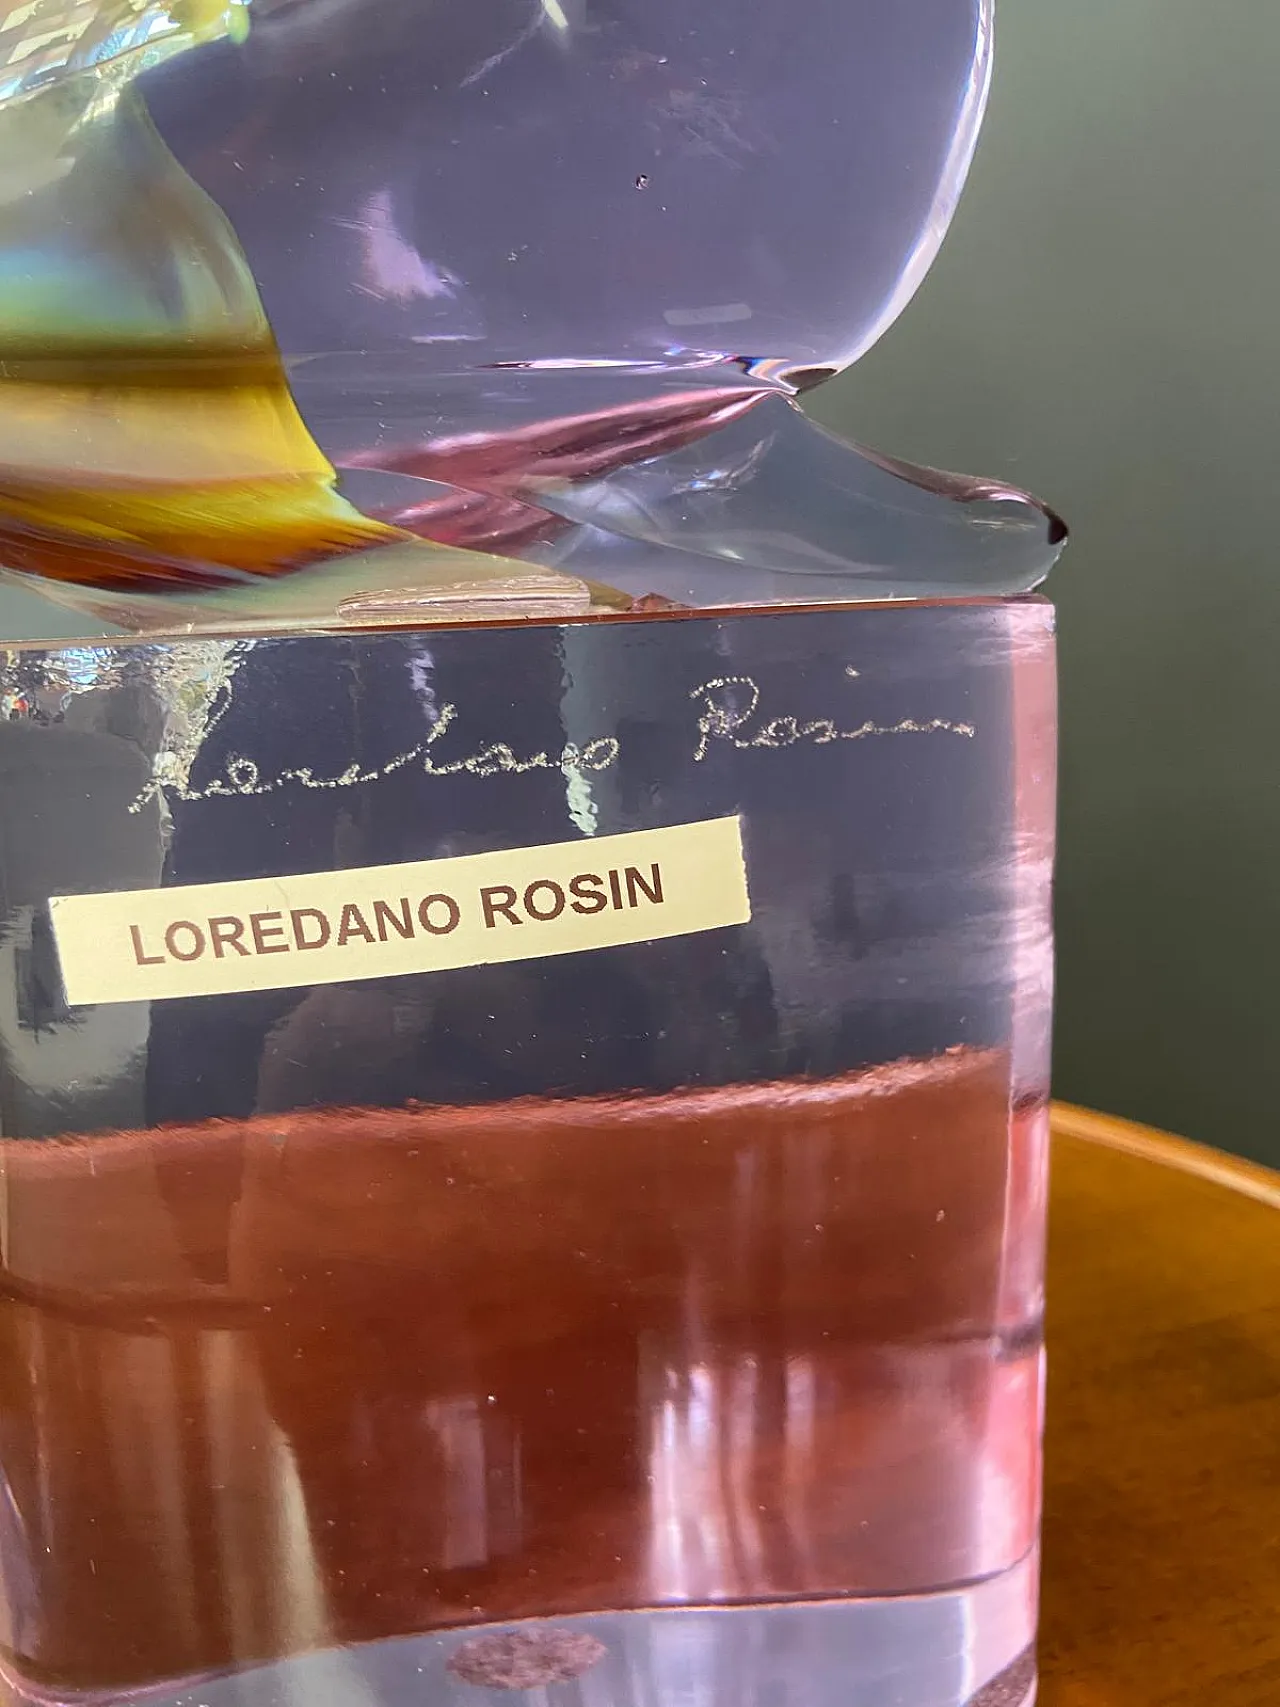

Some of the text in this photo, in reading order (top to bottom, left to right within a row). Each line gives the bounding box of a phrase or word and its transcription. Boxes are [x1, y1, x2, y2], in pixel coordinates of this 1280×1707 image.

[689, 666, 976, 762] Rosin
[130, 862, 665, 966] LOREDANO ROSIN
